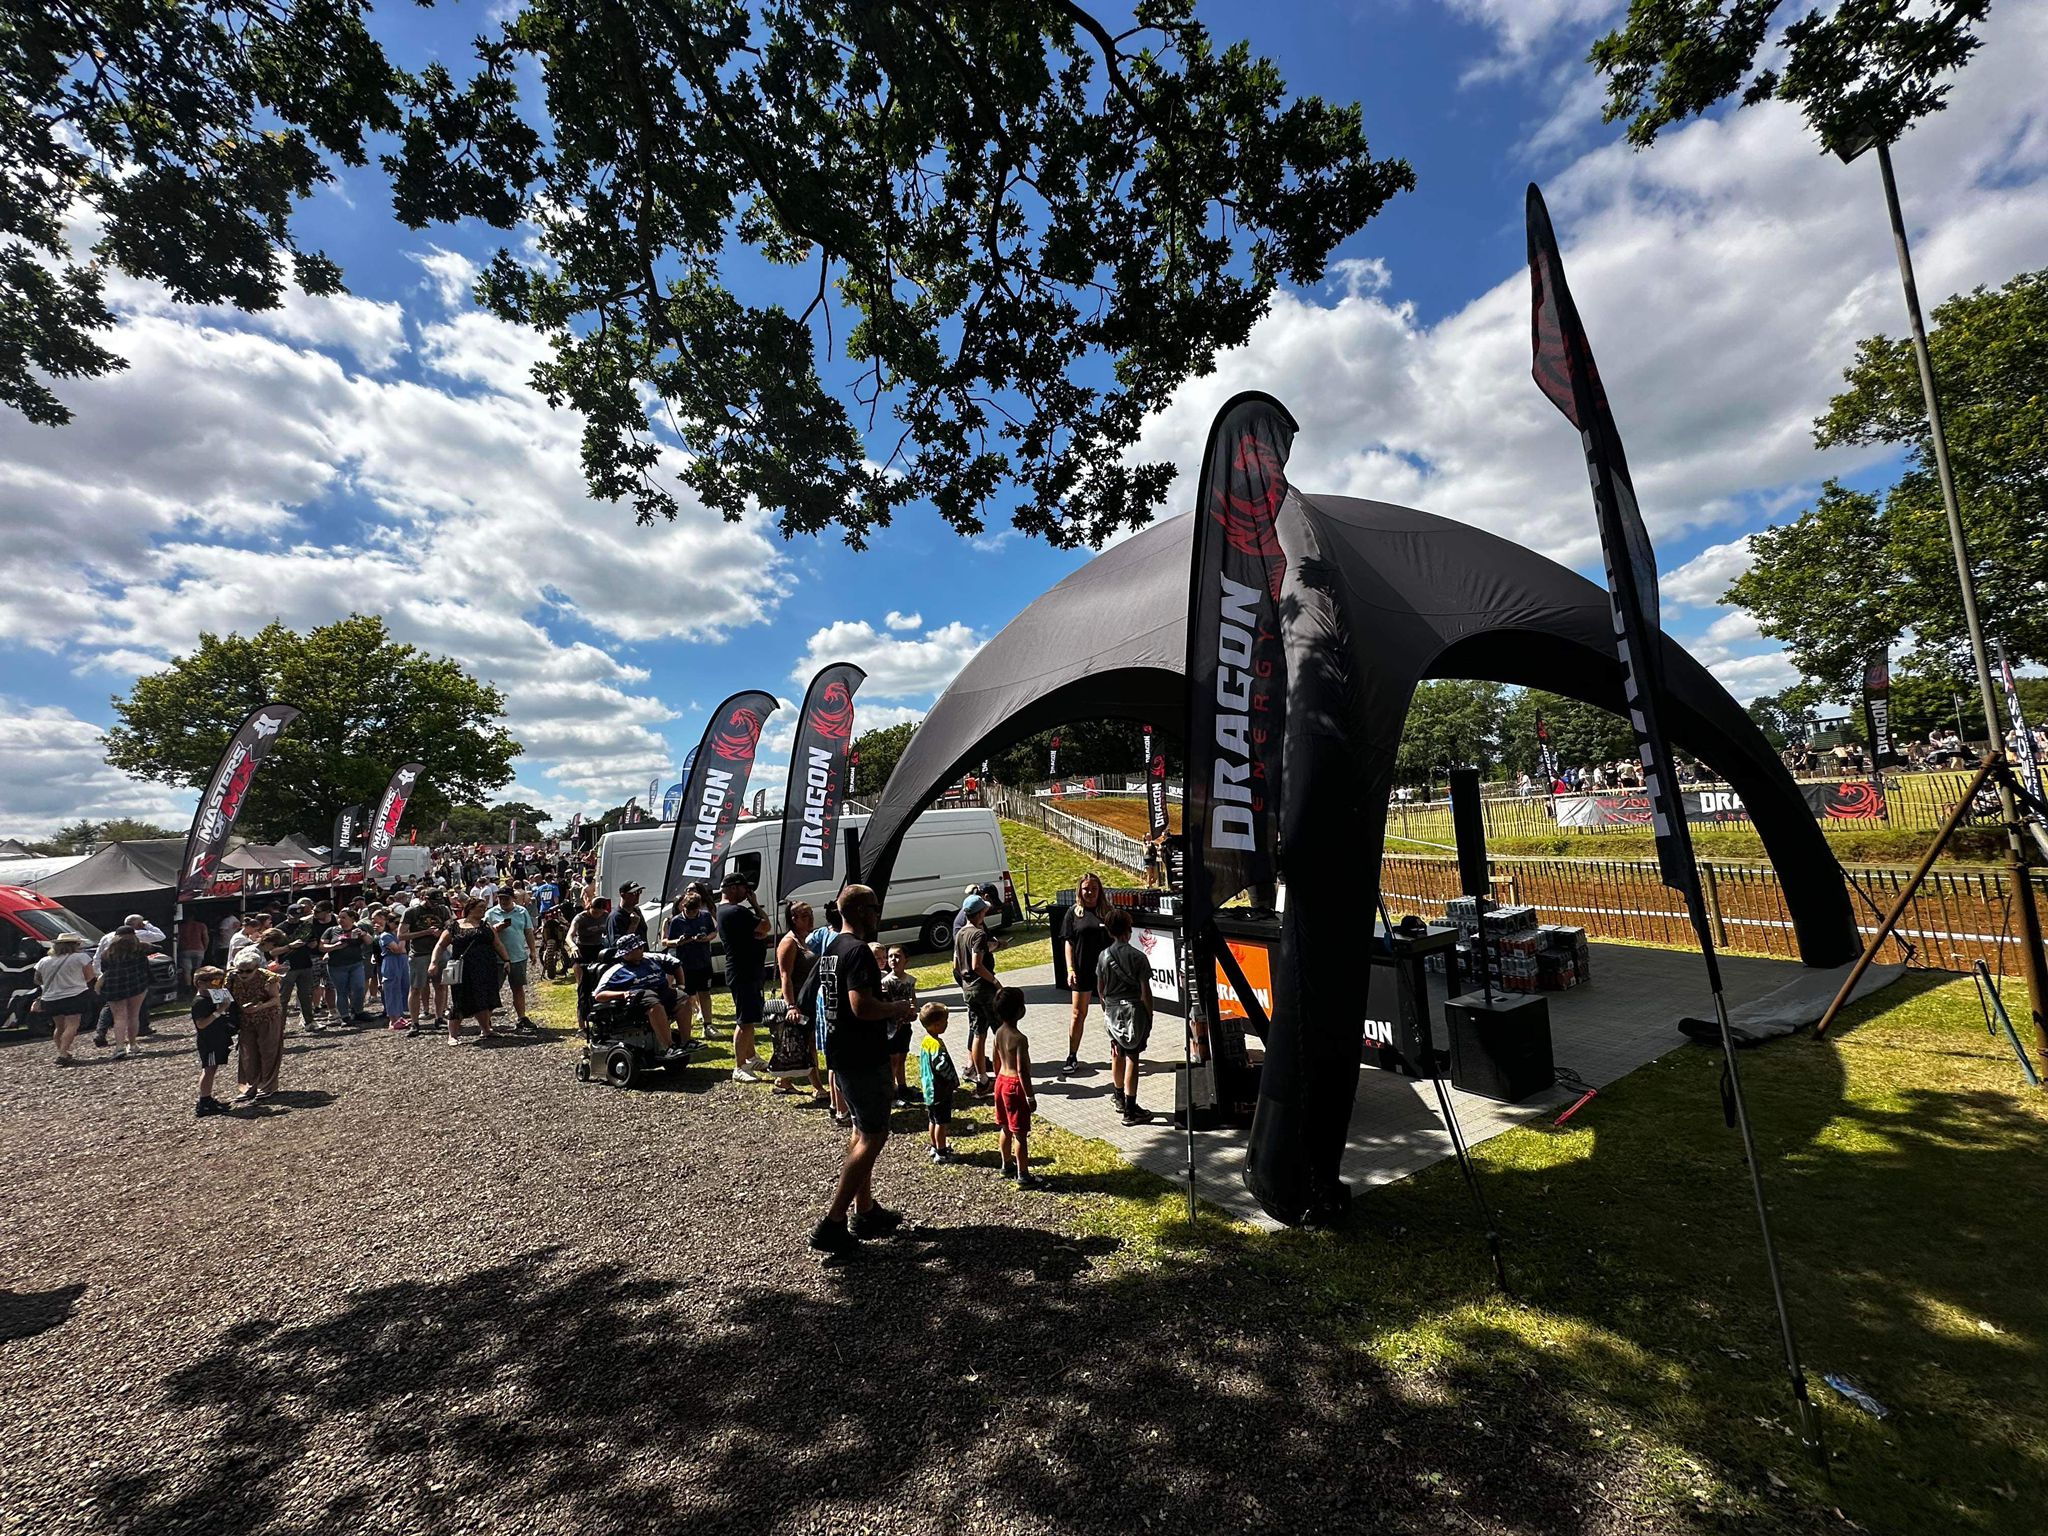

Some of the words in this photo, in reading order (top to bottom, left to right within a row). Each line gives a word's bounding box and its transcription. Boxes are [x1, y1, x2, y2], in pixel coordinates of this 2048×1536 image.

[1211, 570, 1263, 853] DRAGON
[1252, 629, 1275, 812] ENERGY
[1869, 699, 1891, 755] DRAGON
[198, 746, 247, 844] MASTERS
[372, 790, 397, 849] MASTERS
[682, 767, 734, 879] DRAGON
[795, 746, 833, 867] DRAGON
[823, 769, 838, 850] ENERGY
[1152, 782, 1165, 829] DRAGON
[1699, 792, 1746, 813] DRA
[1715, 812, 1749, 821] ENE
[212, 814, 227, 842] OF
[711, 788, 736, 863] ENERGY
[541, 891, 553, 901] 40
[1151, 968, 1175, 987] GON
